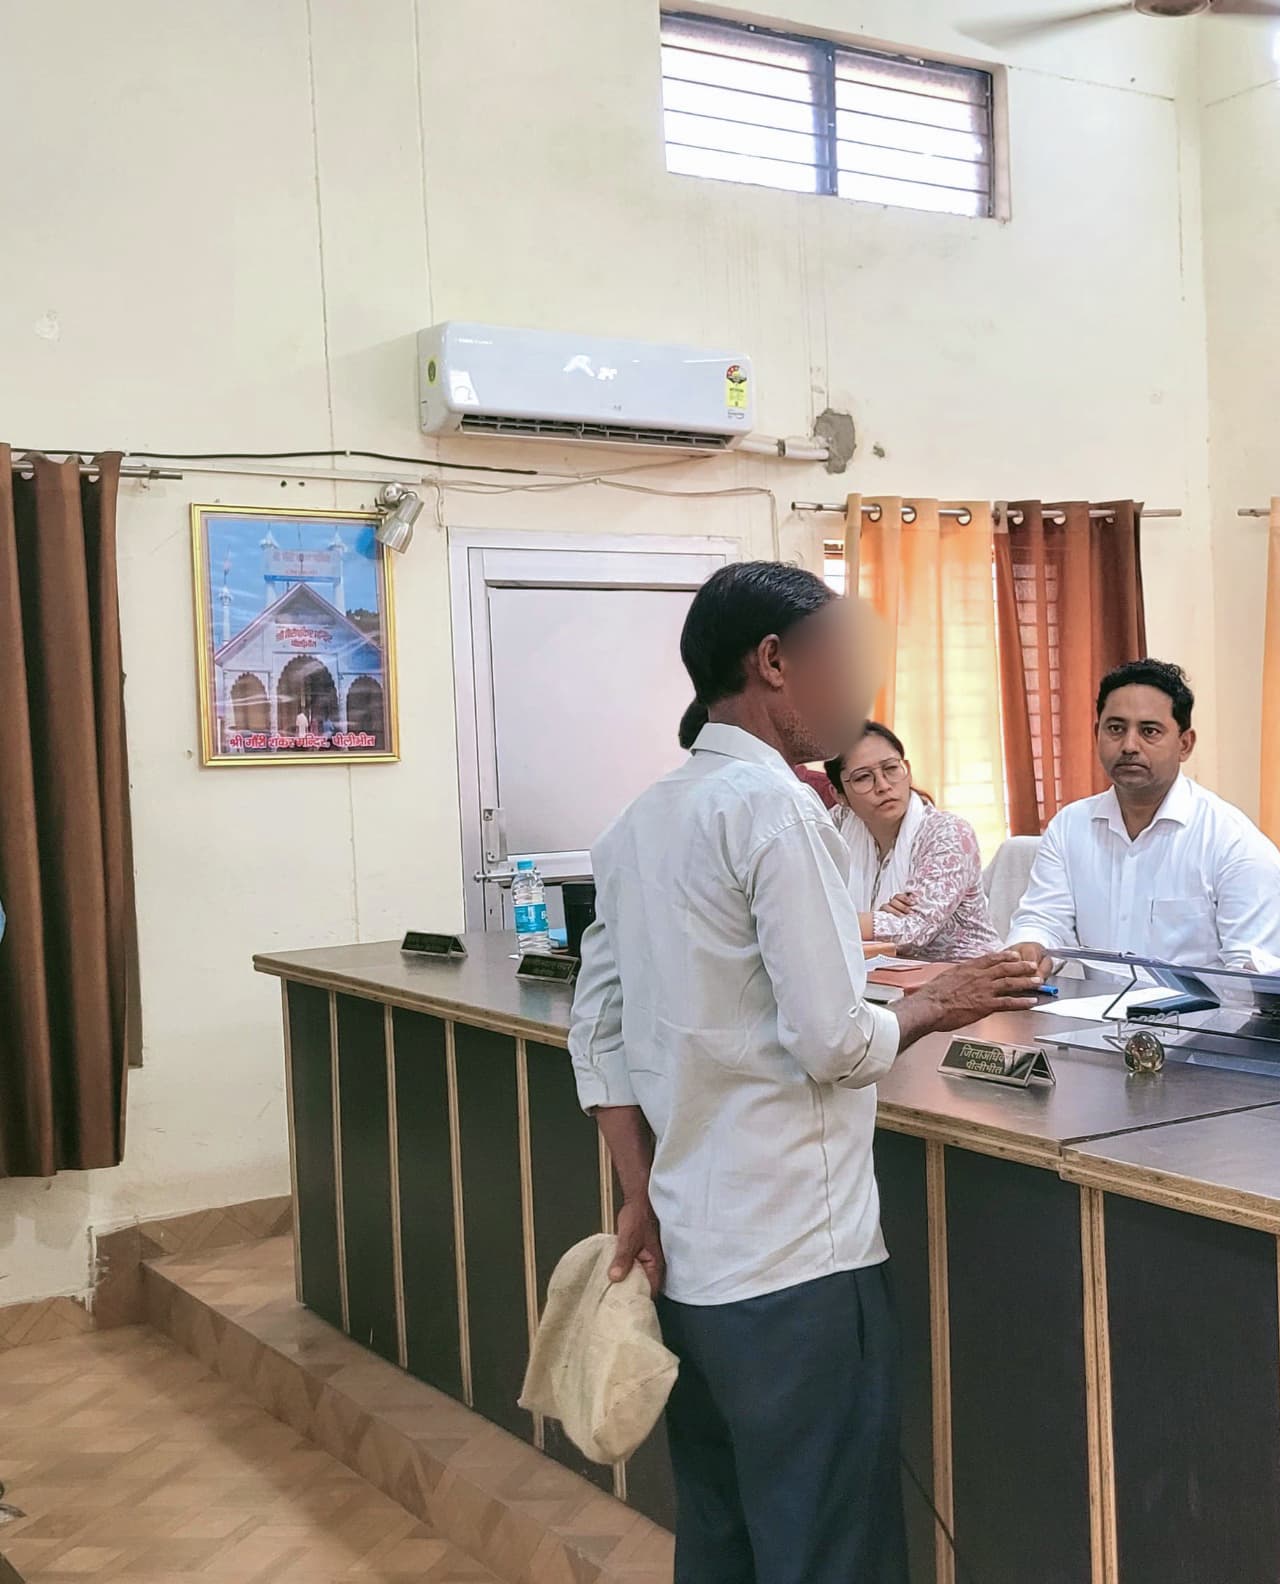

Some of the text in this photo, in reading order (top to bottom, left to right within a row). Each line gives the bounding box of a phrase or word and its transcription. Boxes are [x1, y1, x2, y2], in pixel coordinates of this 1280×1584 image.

[229, 734, 244, 748] श्री
[332, 732, 376, 748] पीलीभीत
[966, 1059, 1004, 1074] पीलीभीत
